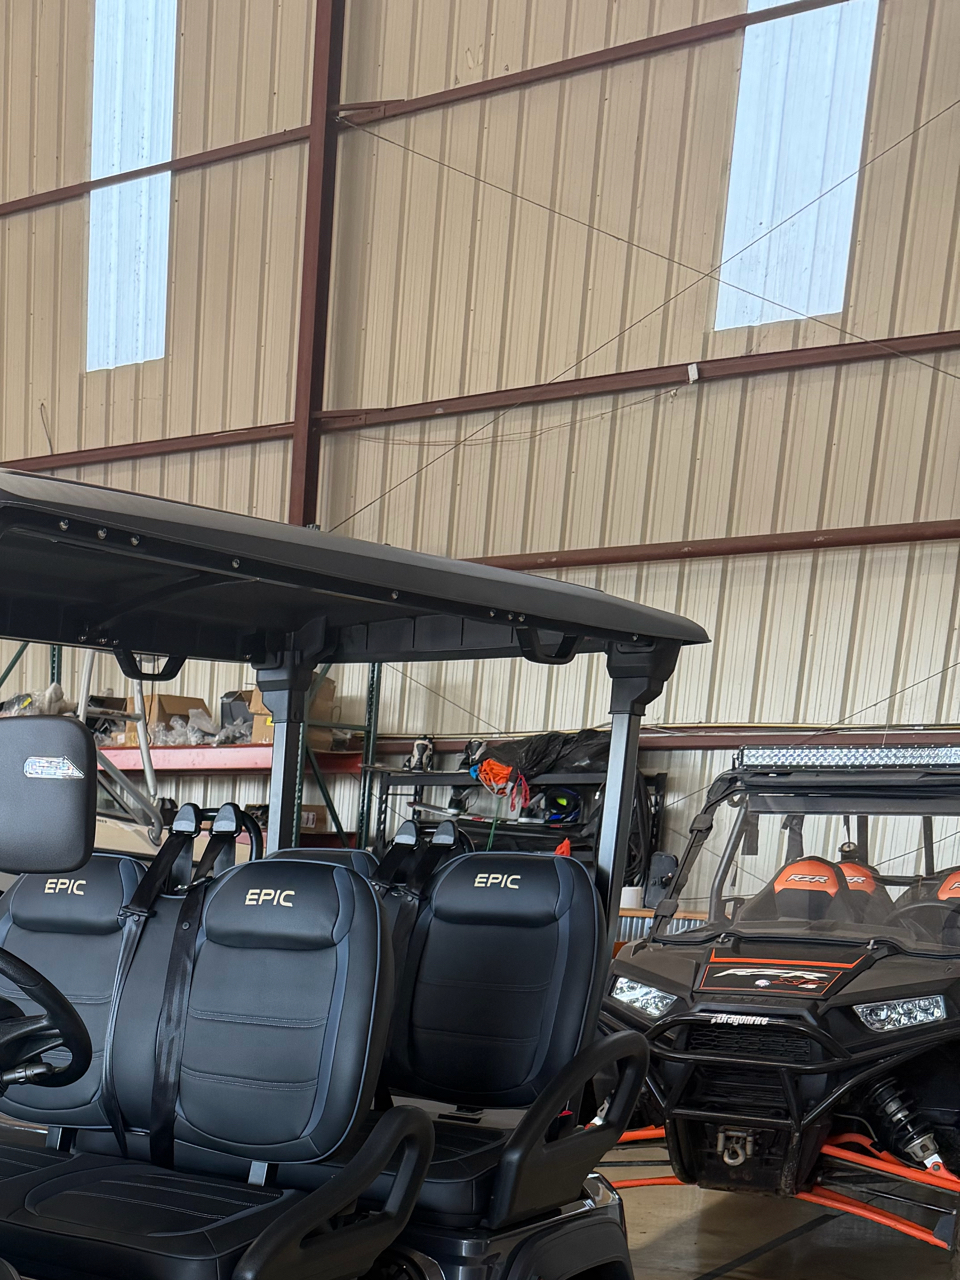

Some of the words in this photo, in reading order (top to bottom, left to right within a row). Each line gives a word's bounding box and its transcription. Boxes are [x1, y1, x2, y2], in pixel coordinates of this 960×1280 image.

[44, 877, 87, 896] EPIC
[474, 873, 521, 889] EPIC
[786, 874, 828, 884] RZR
[244, 888, 295, 908] EPIC
[716, 1013, 769, 1026] Dragonfire
